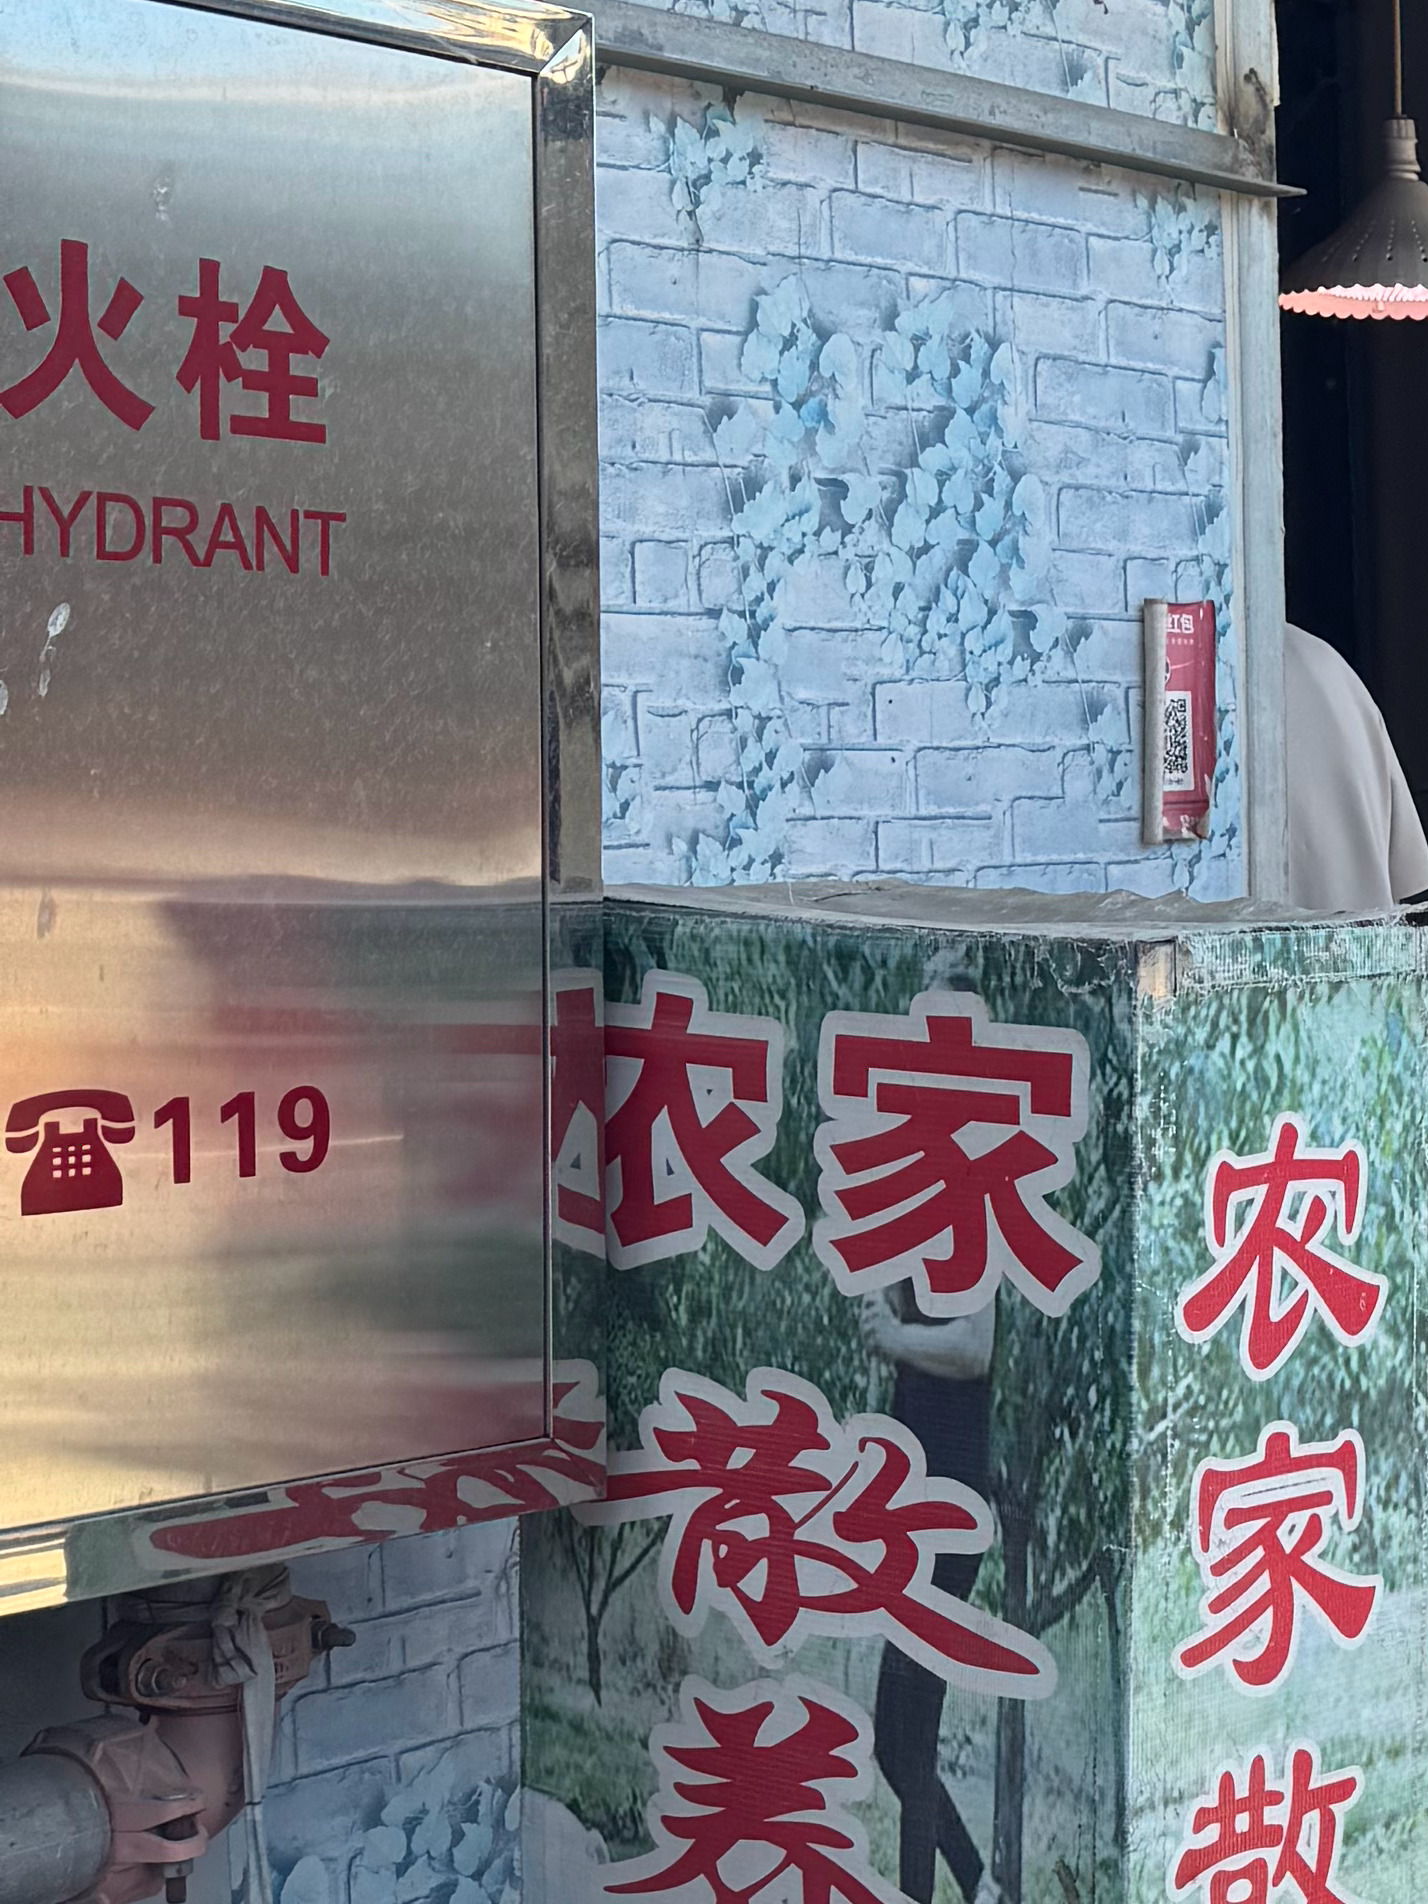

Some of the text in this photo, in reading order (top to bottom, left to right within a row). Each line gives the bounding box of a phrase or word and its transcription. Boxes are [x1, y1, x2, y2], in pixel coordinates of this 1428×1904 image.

[1, 238, 330, 444] 火栓
[149, 1084, 332, 1187] 119
[605, 980, 1095, 1308] 农家
